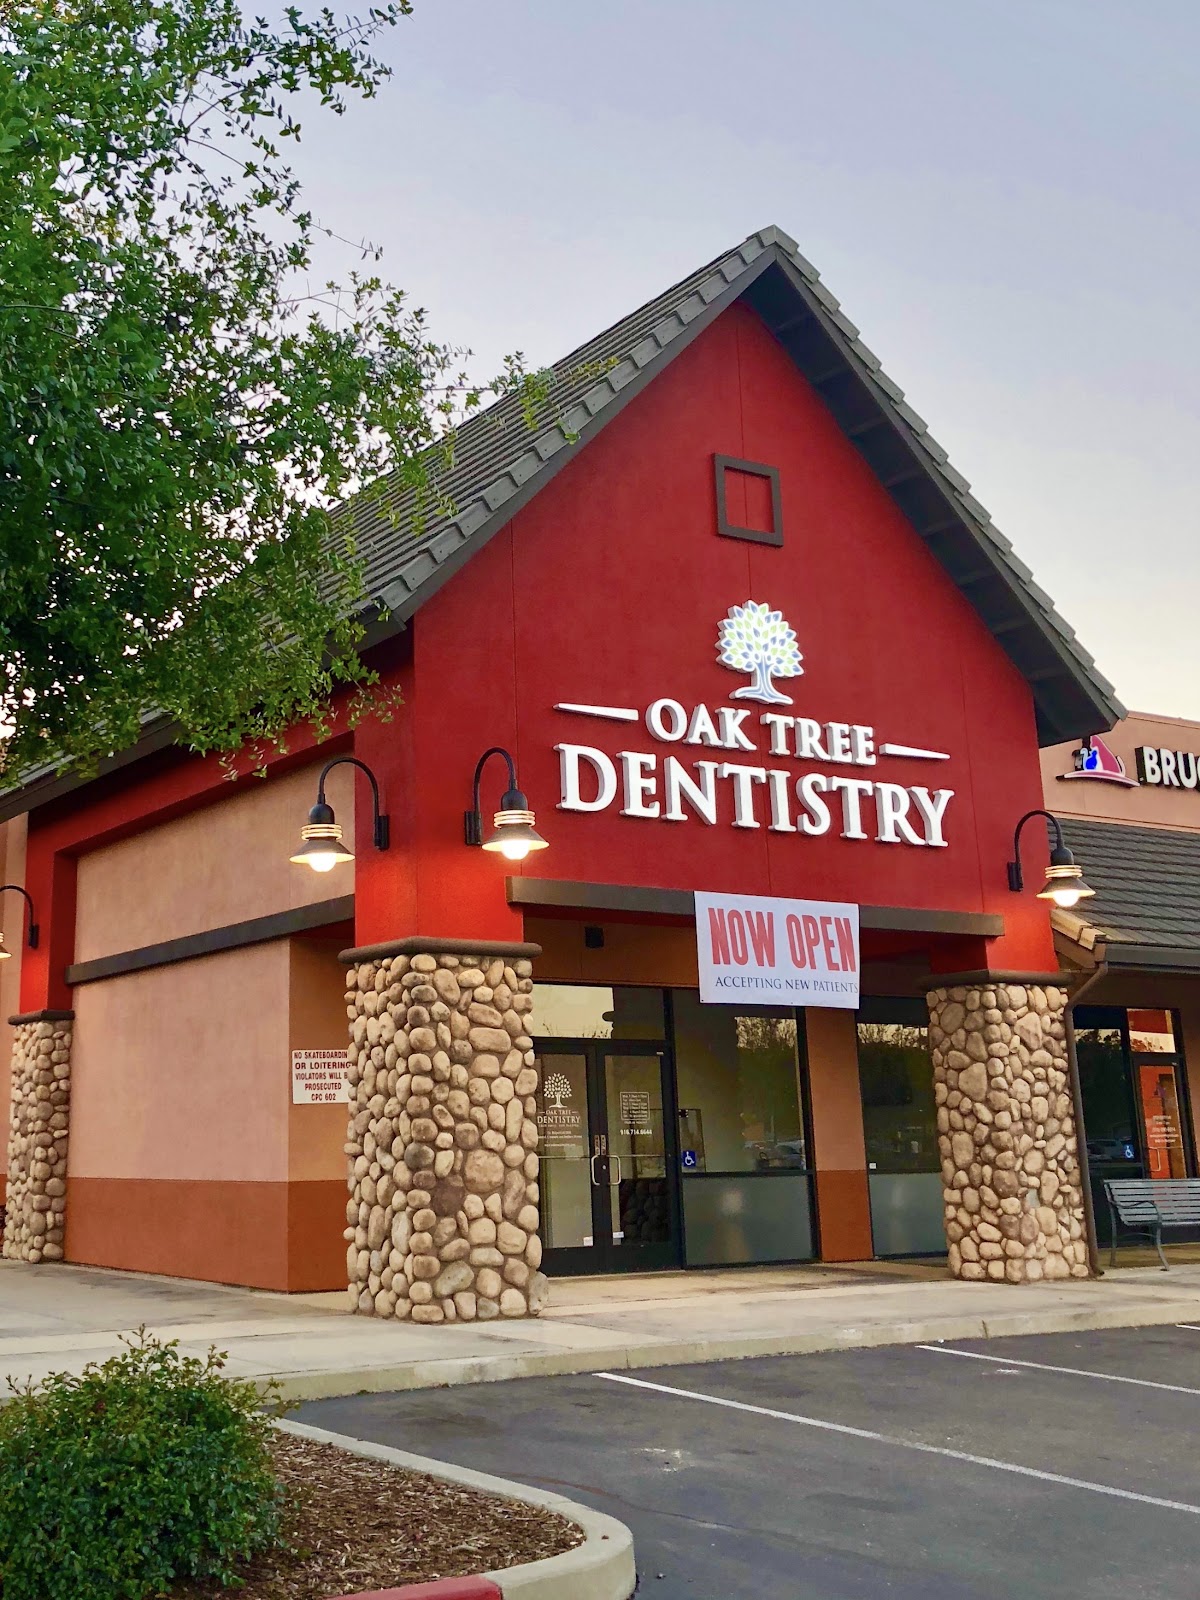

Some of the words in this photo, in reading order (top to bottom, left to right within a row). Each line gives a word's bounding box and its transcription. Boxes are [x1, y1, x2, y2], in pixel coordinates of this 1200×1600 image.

[645, 698, 756, 751] OAK
[760, 712, 877, 766] TREE
[1142, 746, 1200, 789] BRU
[554, 743, 955, 847] DENTISTRY
[708, 908, 775, 967] NOW
[786, 914, 856, 972] OPEN
[715, 976, 782, 989] ACCEPTING
[785, 979, 810, 991] NEW
[814, 980, 858, 993] PATIENTS
[294, 1051, 303, 1059] NO
[304, 1051, 348, 1059] SKATEBOARDIN
[295, 1062, 306, 1070] OR
[310, 1061, 351, 1070] LOITERING
[295, 1072, 327, 1080] VIOLATORS
[329, 1072, 342, 1080] WILL
[304, 1082, 342, 1090] PROSECUTED
[311, 1093, 323, 1101] CPC
[325, 1093, 336, 1101] 602
[537, 1115, 581, 1124] DENTISTRY
